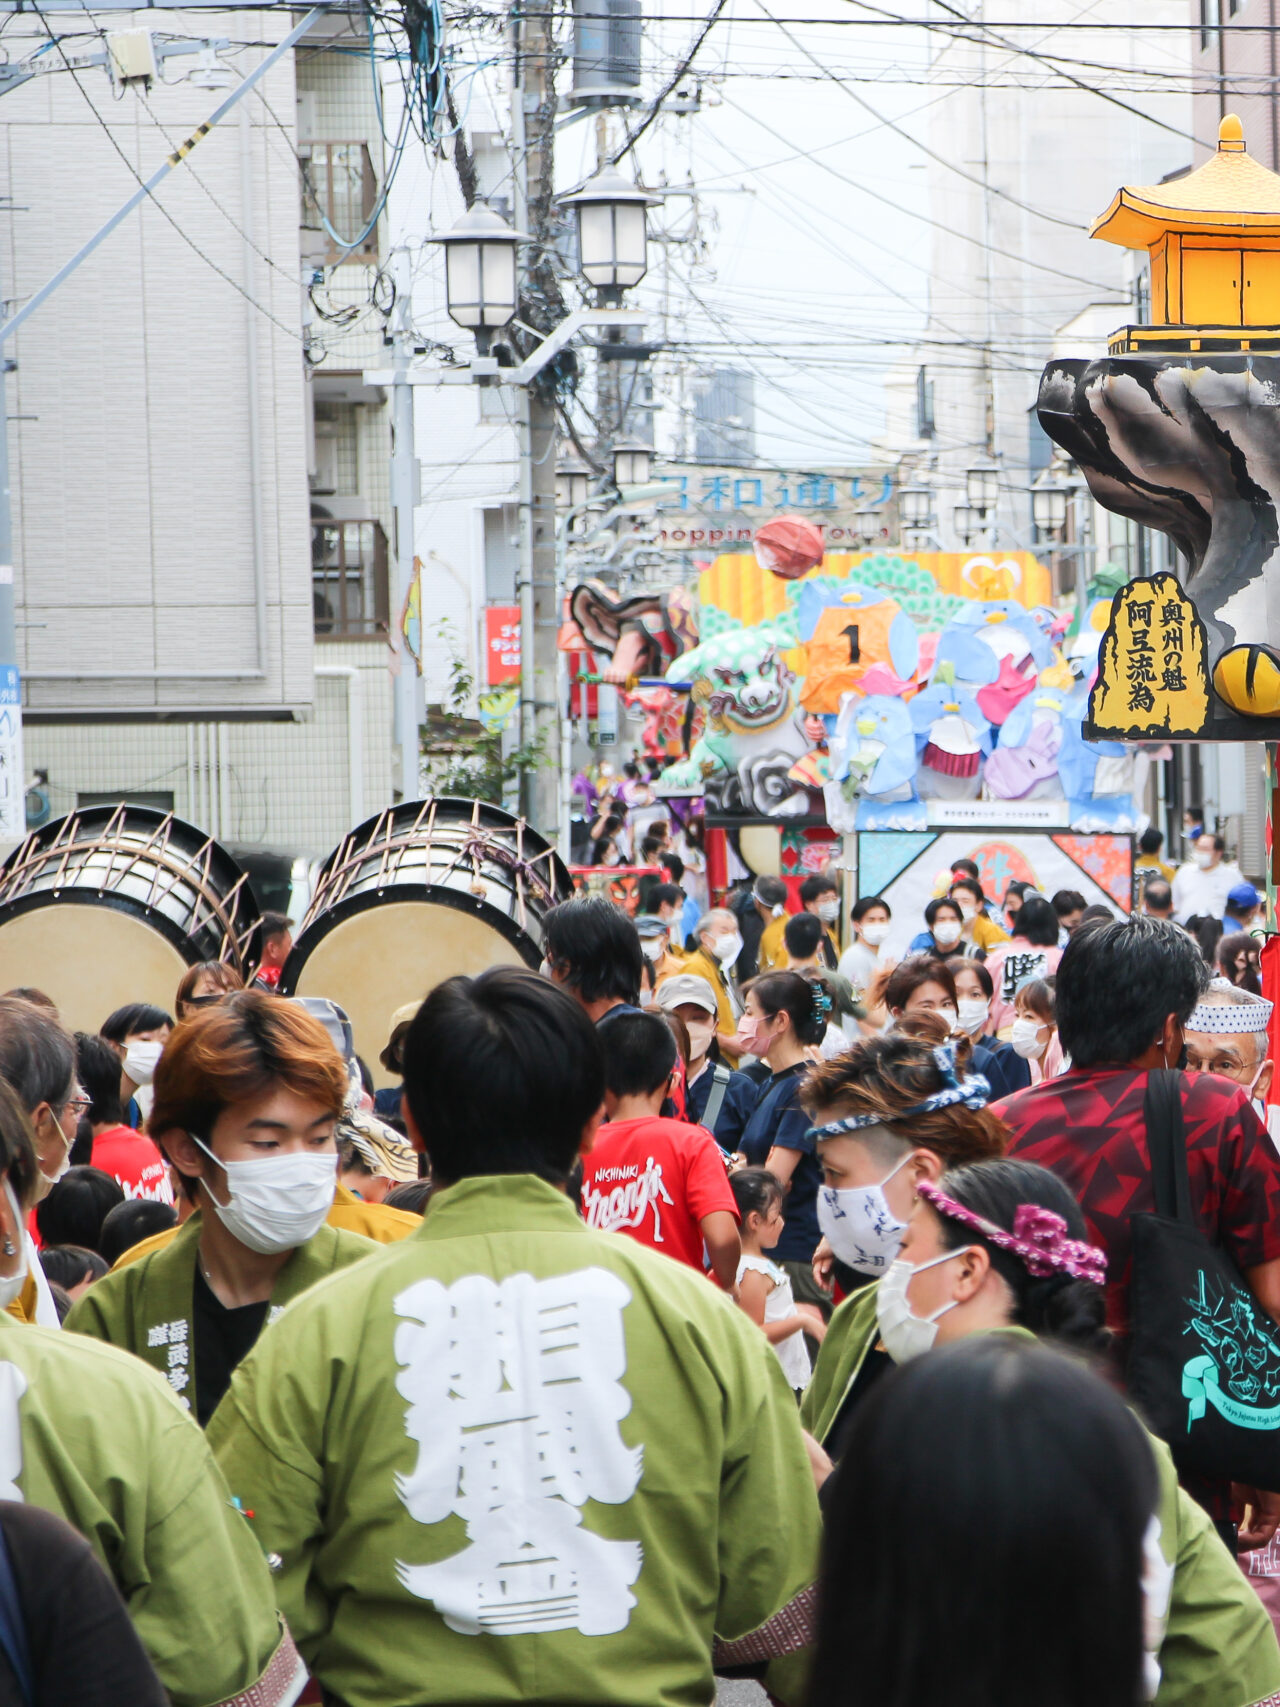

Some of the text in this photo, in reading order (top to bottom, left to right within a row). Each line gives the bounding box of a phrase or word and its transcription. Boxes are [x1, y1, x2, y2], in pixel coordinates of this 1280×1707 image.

[838, 624, 861, 664] 1
[1126, 599, 1158, 713] 阿弖流為
[1157, 599, 1188, 692] 奥州の魁
